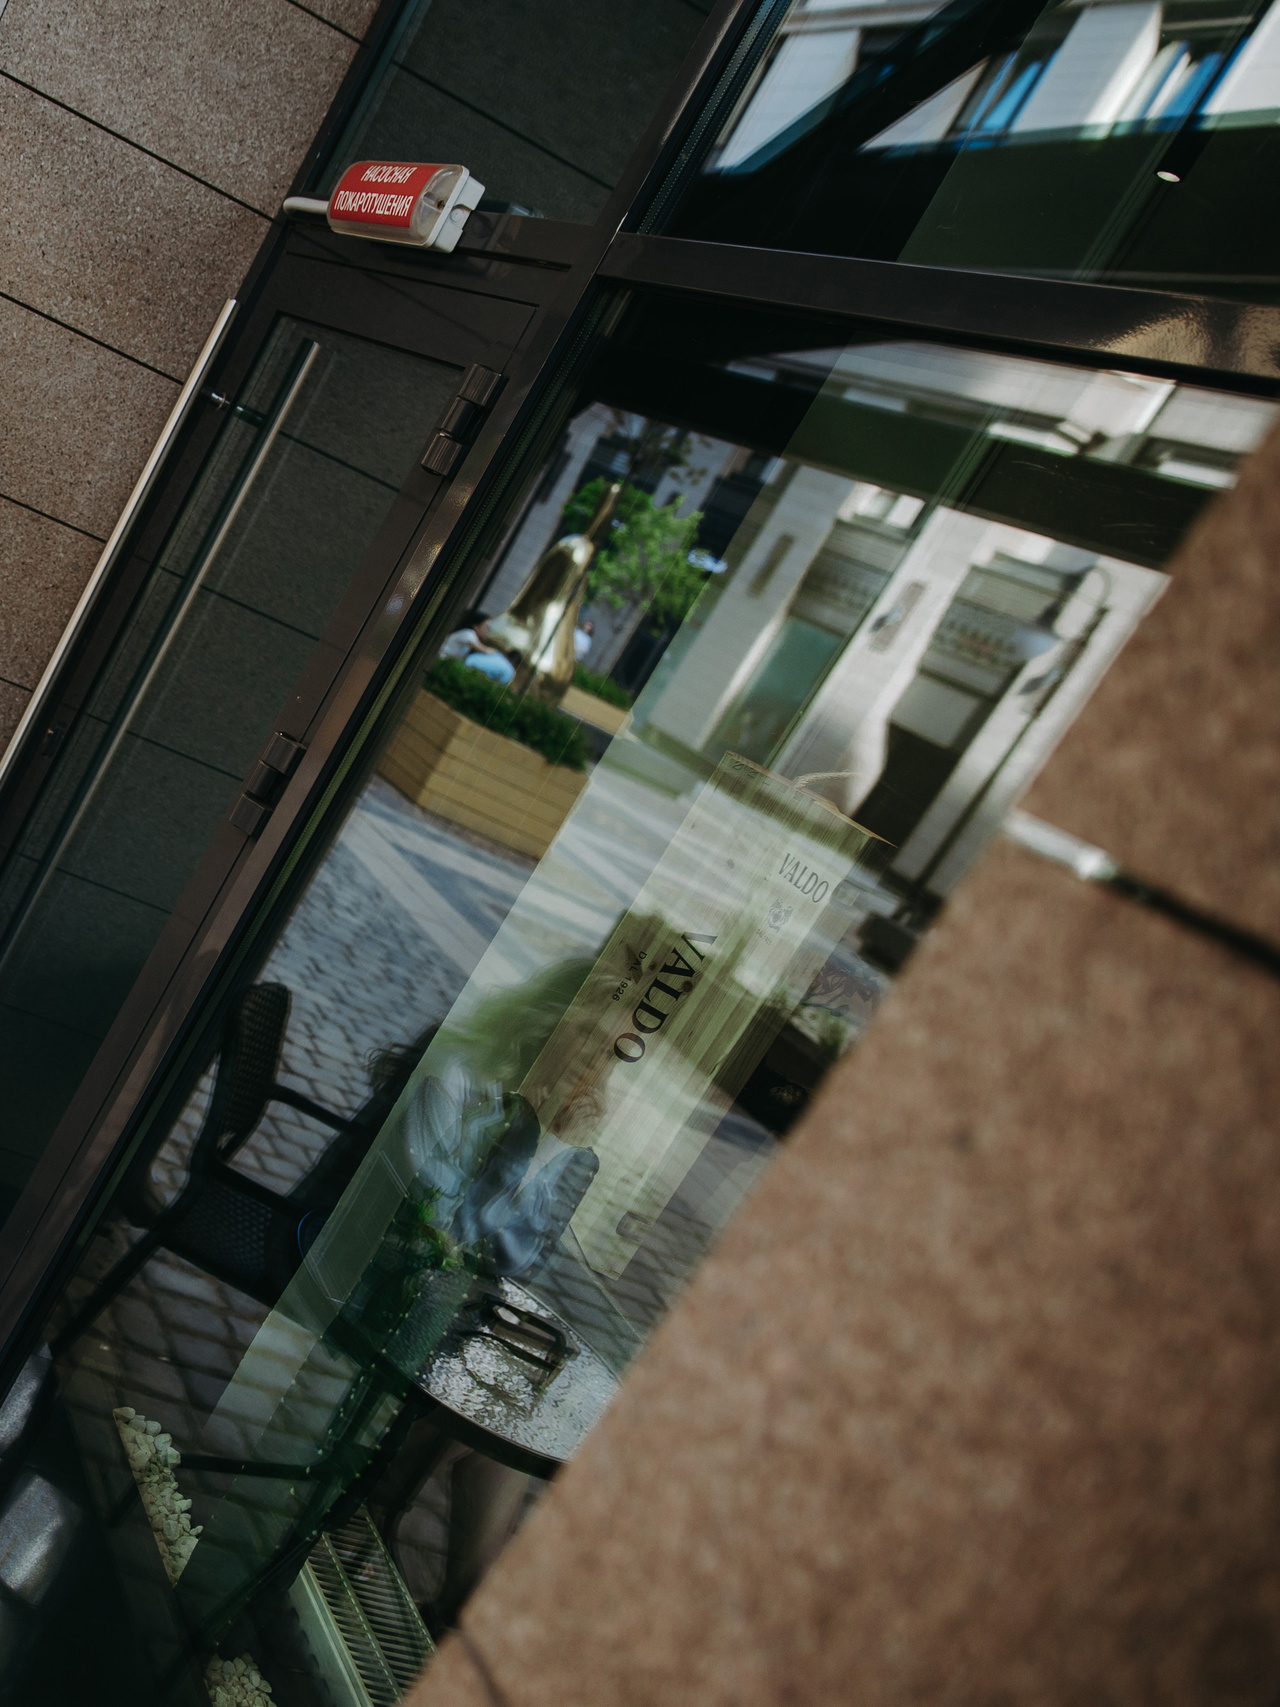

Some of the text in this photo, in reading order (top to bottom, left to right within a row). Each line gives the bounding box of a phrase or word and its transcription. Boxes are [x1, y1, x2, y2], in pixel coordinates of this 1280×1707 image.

[360, 165, 418, 184] НАСОСНАЯ
[333, 190, 414, 217] ПОЖАРОТУШЕНИЯ
[778, 853, 829, 903] VALDO
[612, 950, 648, 1002] DAL 1926
[613, 931, 718, 1063] VALDO
